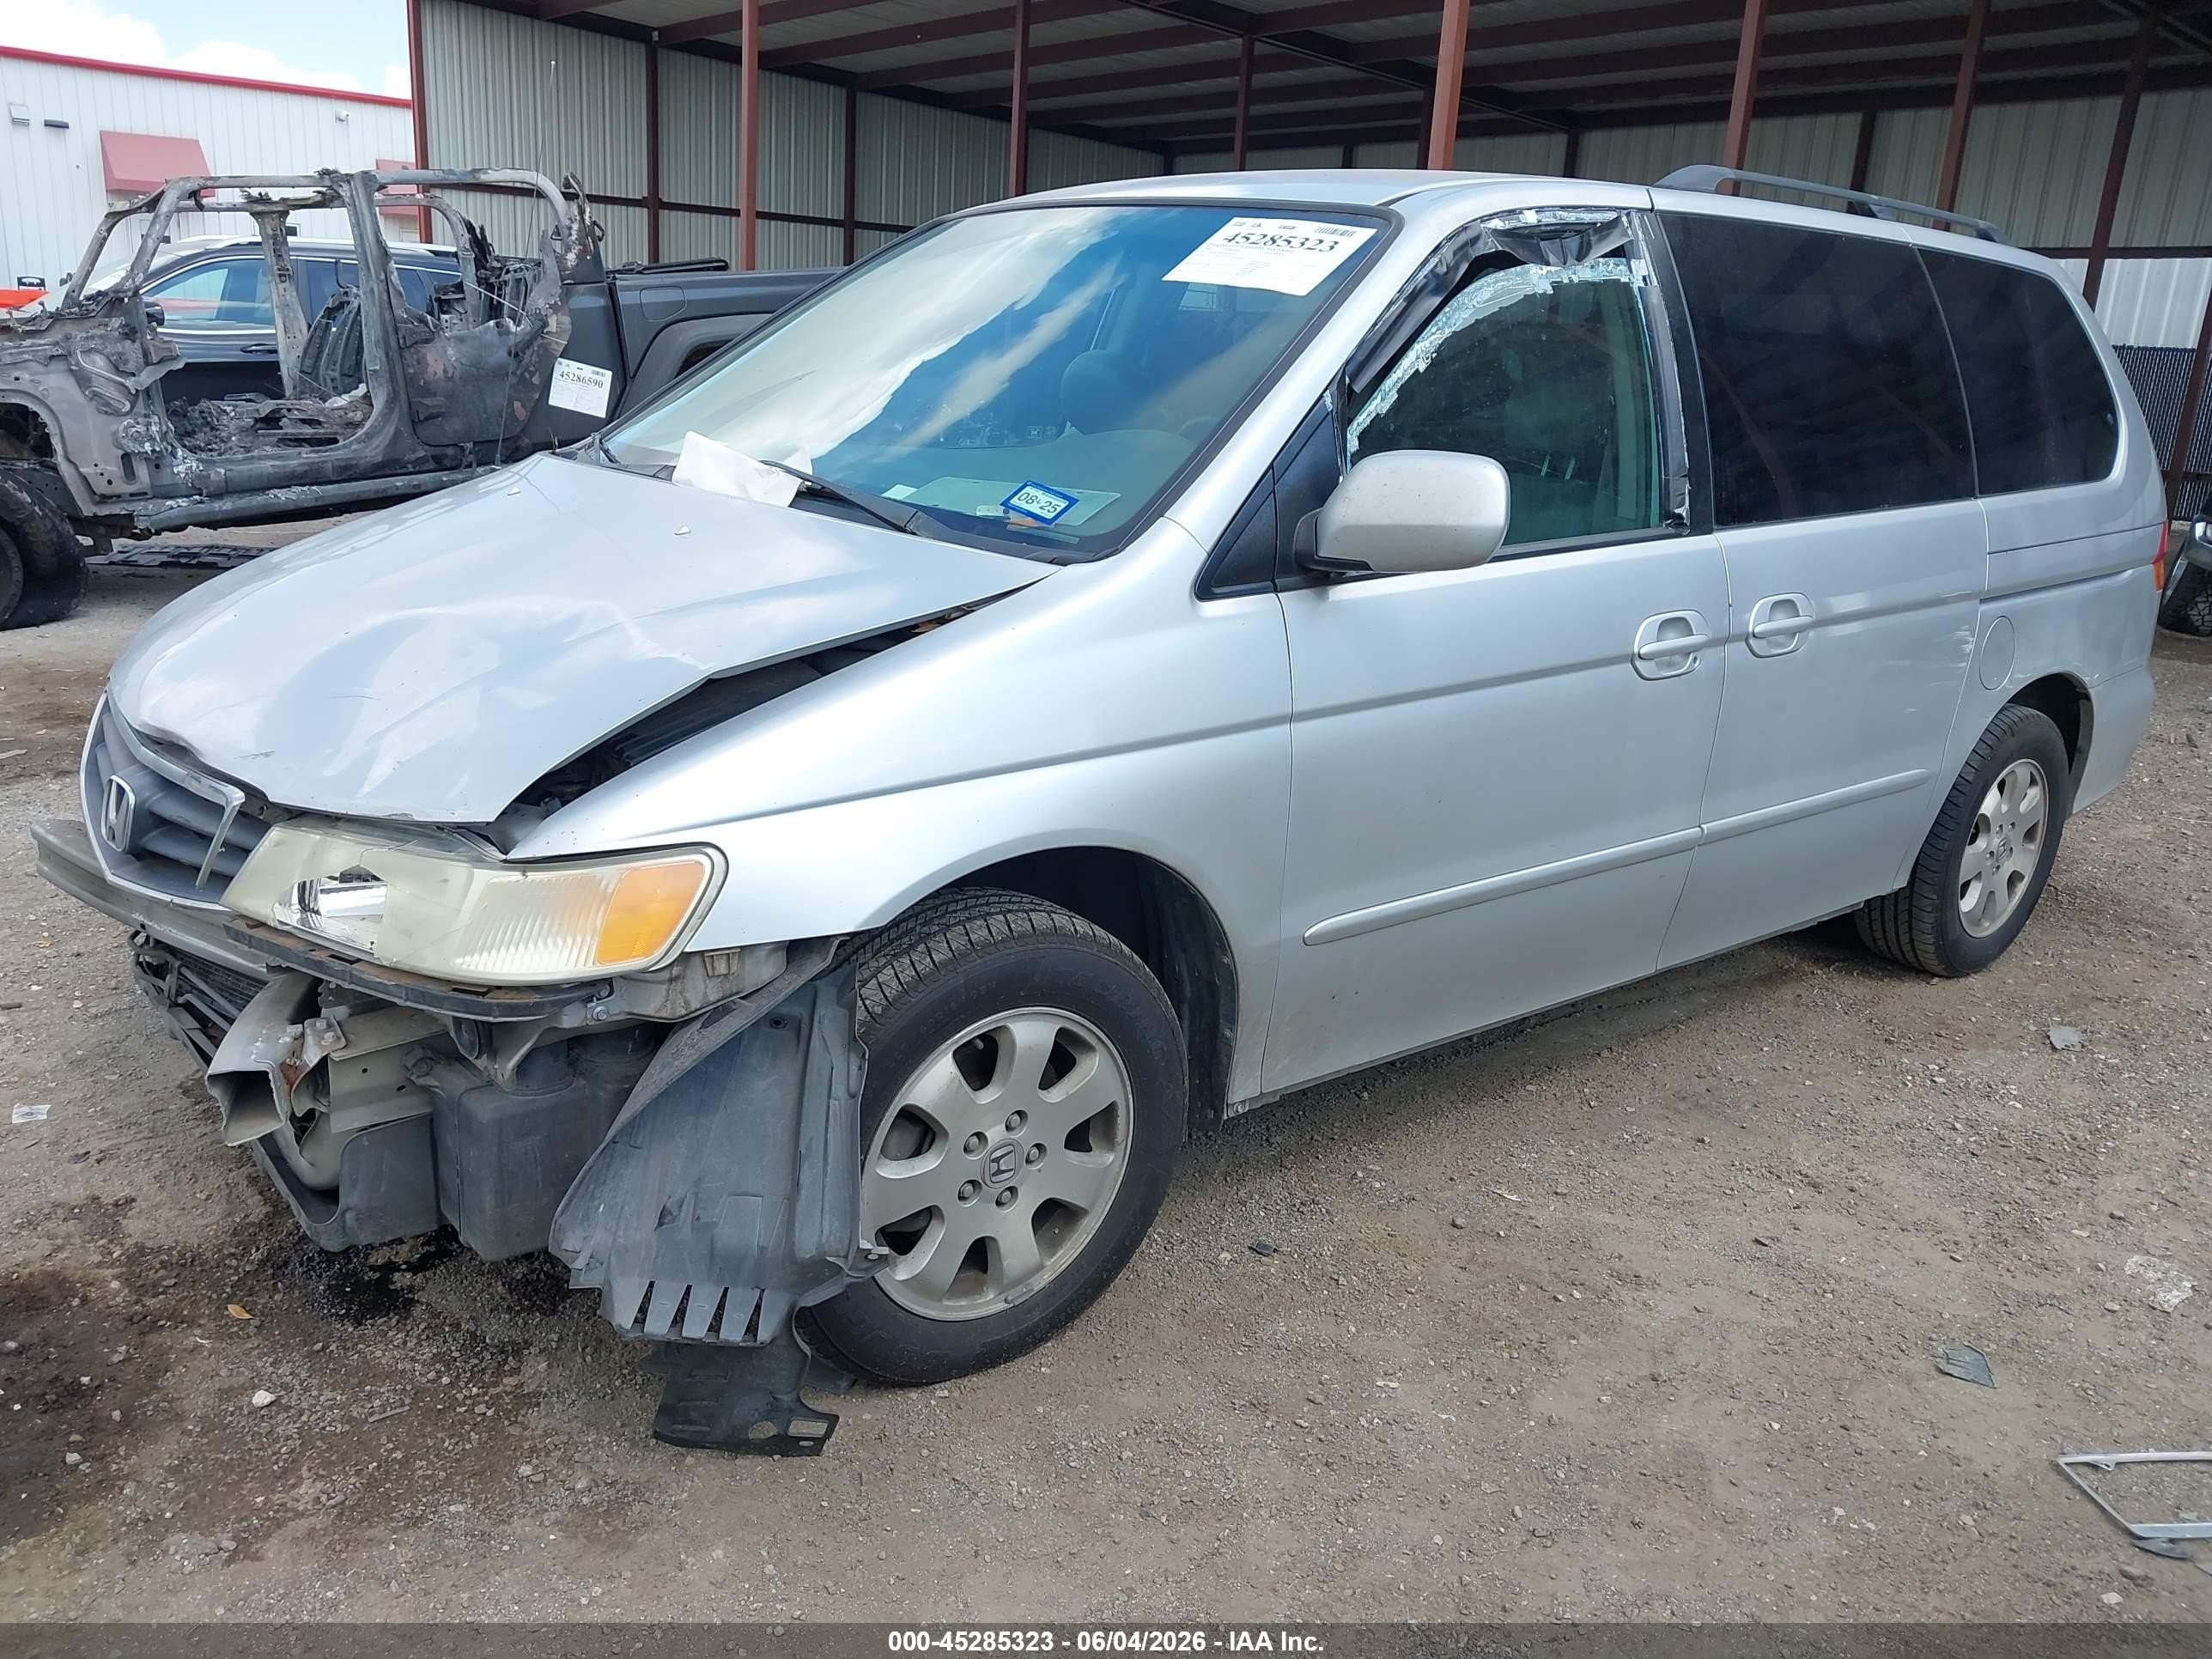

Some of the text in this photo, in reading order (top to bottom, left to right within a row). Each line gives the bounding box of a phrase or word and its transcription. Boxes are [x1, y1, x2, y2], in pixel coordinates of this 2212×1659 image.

[1222, 231, 1340, 252] 45285323
[559, 369, 604, 389] 45286590
[1017, 491, 1039, 505] 08
[1038, 500, 1062, 514] 25
